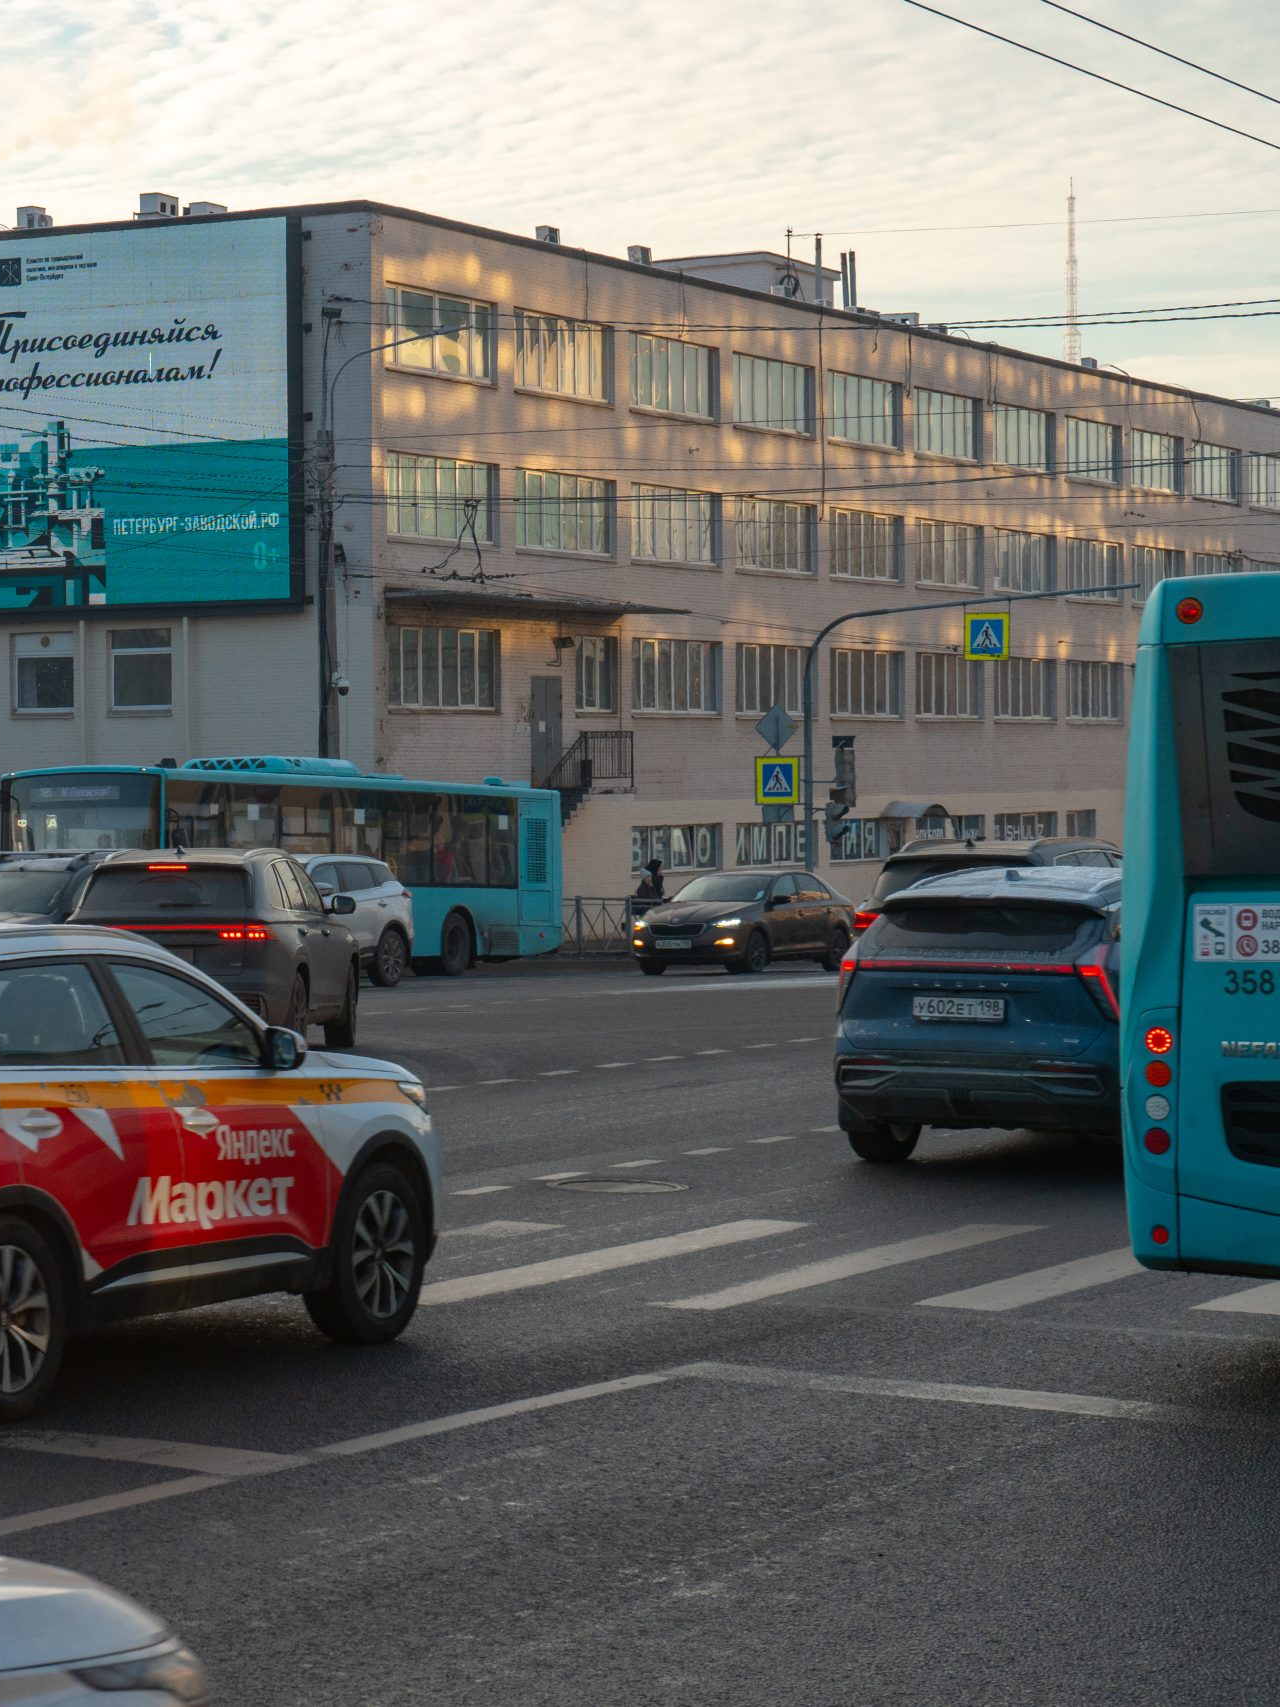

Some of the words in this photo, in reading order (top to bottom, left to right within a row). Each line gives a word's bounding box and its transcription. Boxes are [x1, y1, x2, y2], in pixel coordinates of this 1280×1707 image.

[113, 511, 280, 536] ПЕТЕРБУРГ-ЗАВОДСКОЙ.РФ
[253, 541, 280, 570] 0+
[632, 826, 711, 867] ВЕЛО
[978, 1000, 1000, 1013] 198
[217, 1124, 295, 1165] Яндекс
[126, 1174, 295, 1230] Маркет
